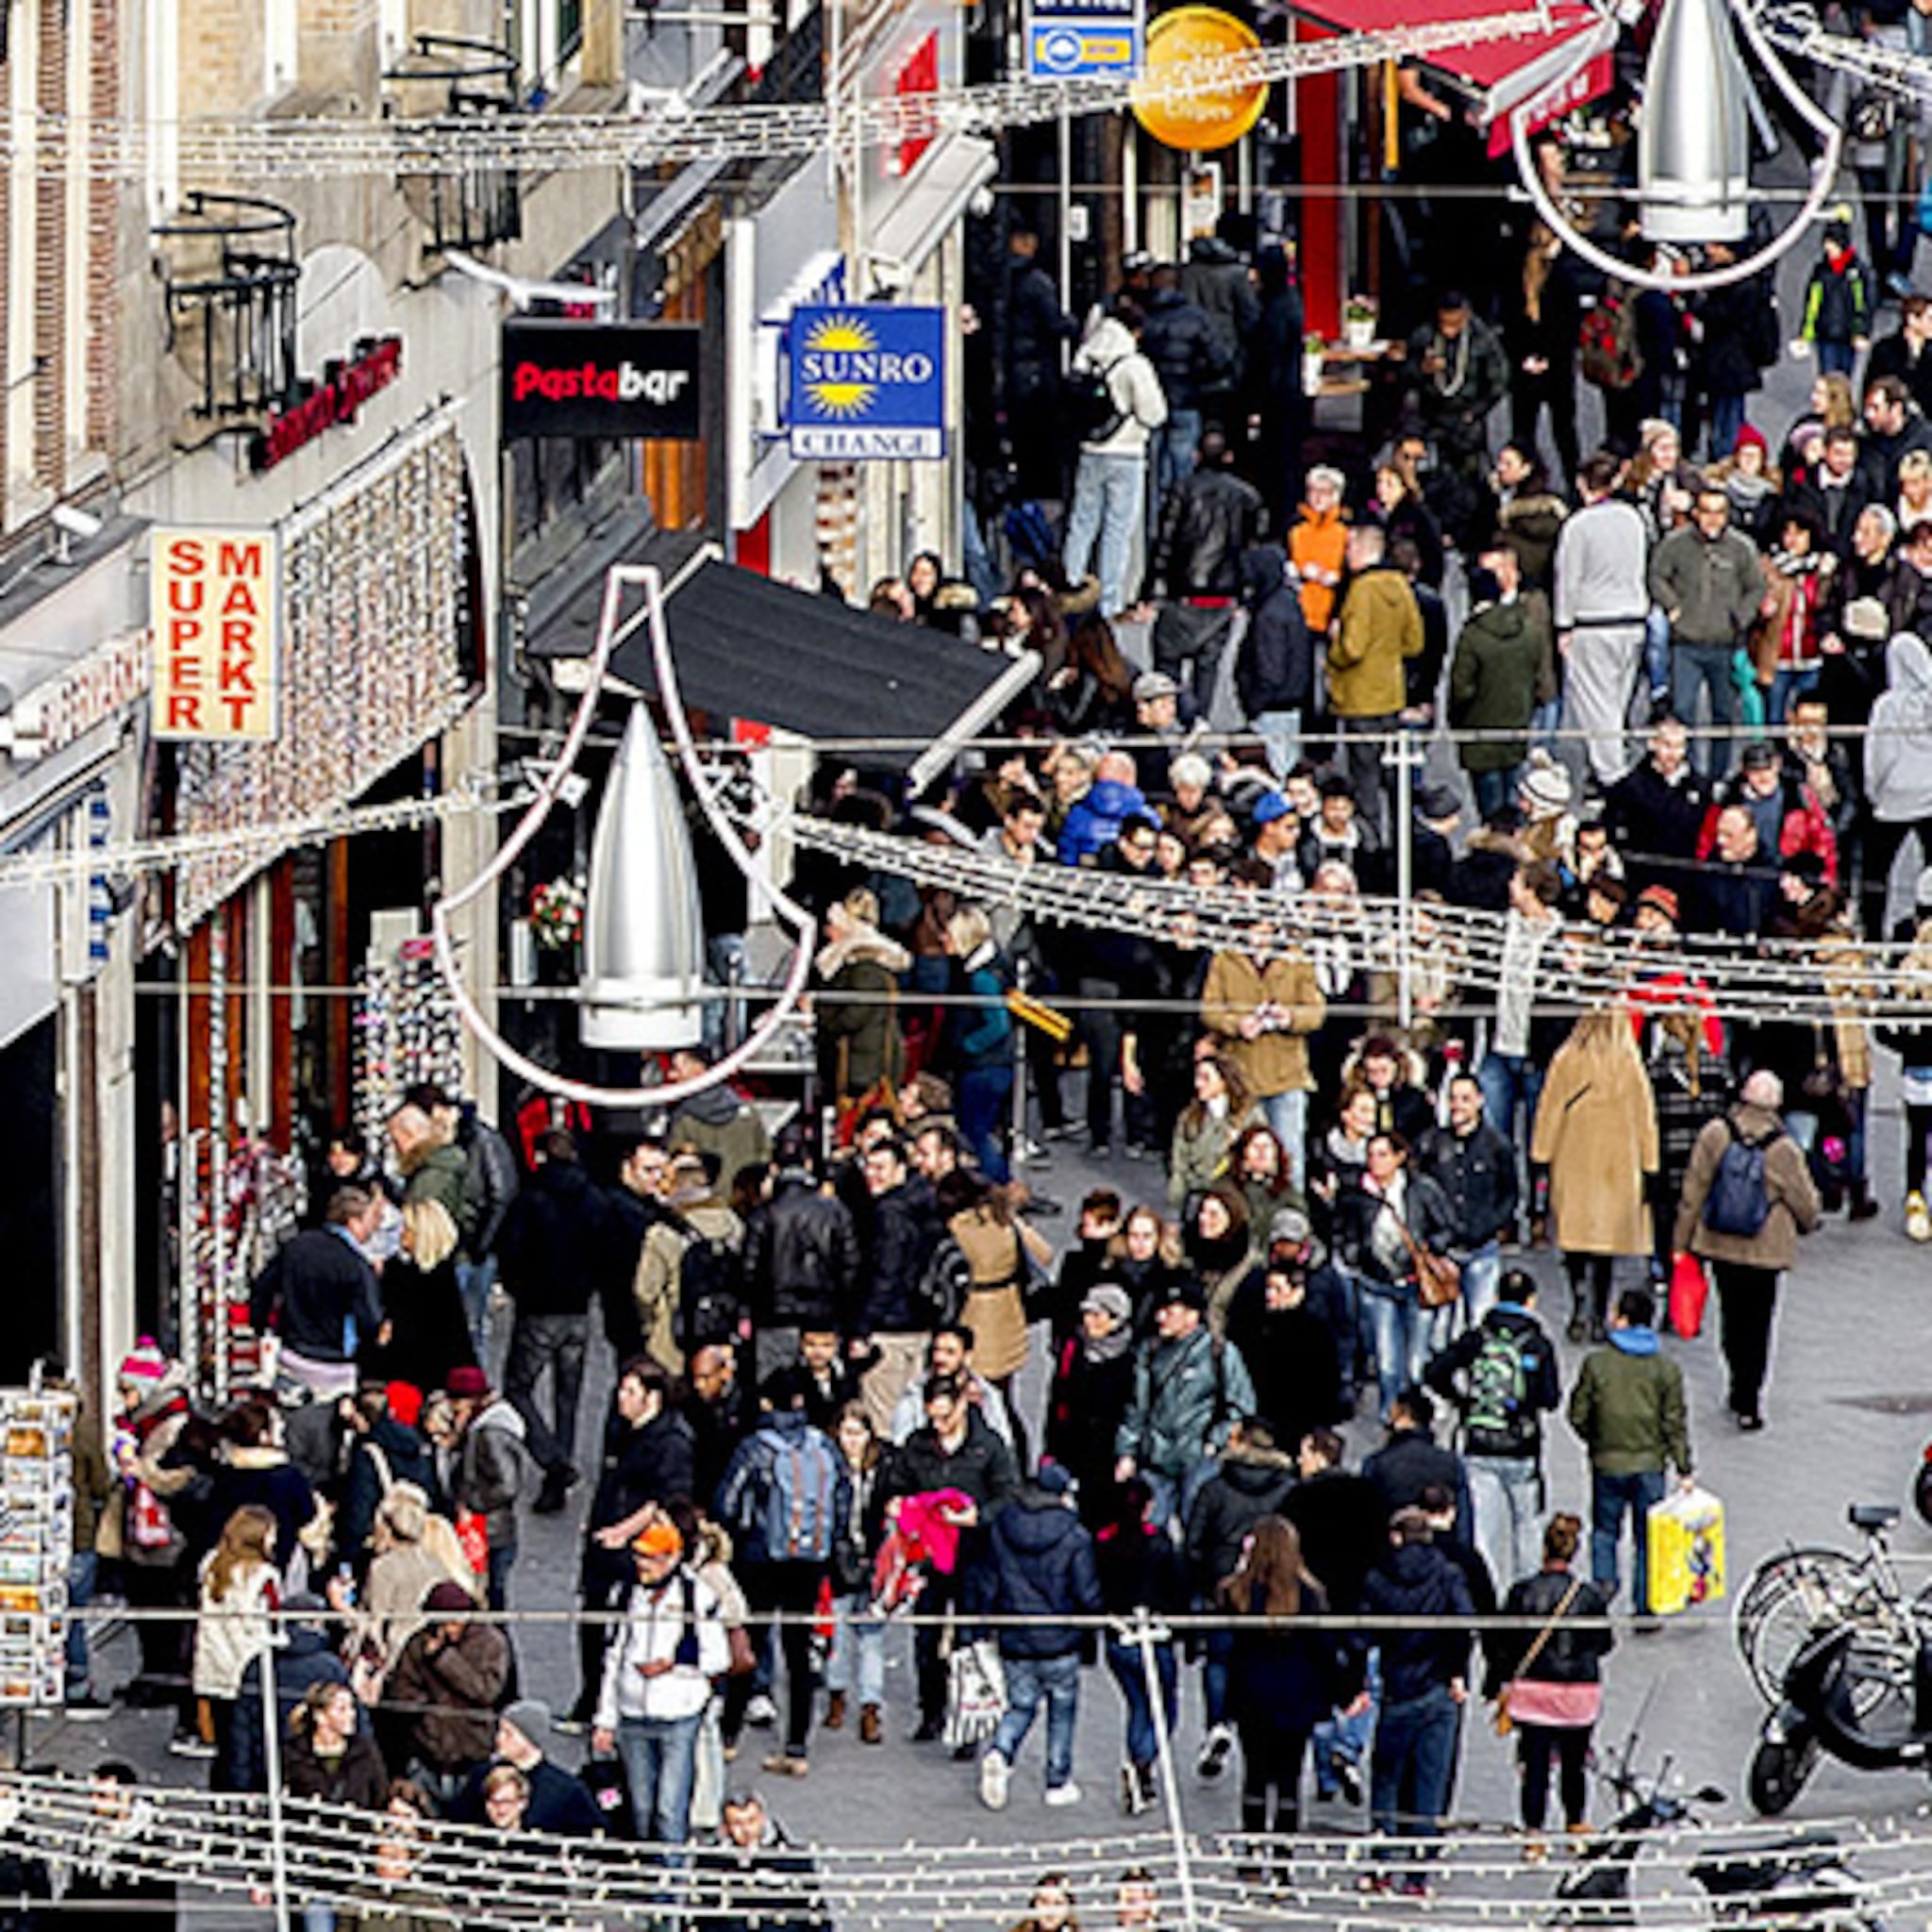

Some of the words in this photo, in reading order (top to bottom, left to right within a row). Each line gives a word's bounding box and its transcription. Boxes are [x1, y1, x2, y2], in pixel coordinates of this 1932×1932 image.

[512, 361, 690, 405] Pastabar
[802, 351, 933, 384] SUNRO
[802, 433, 931, 454] CHANGE
[167, 541, 205, 729] SUPER
[217, 543, 262, 731] MARKT
